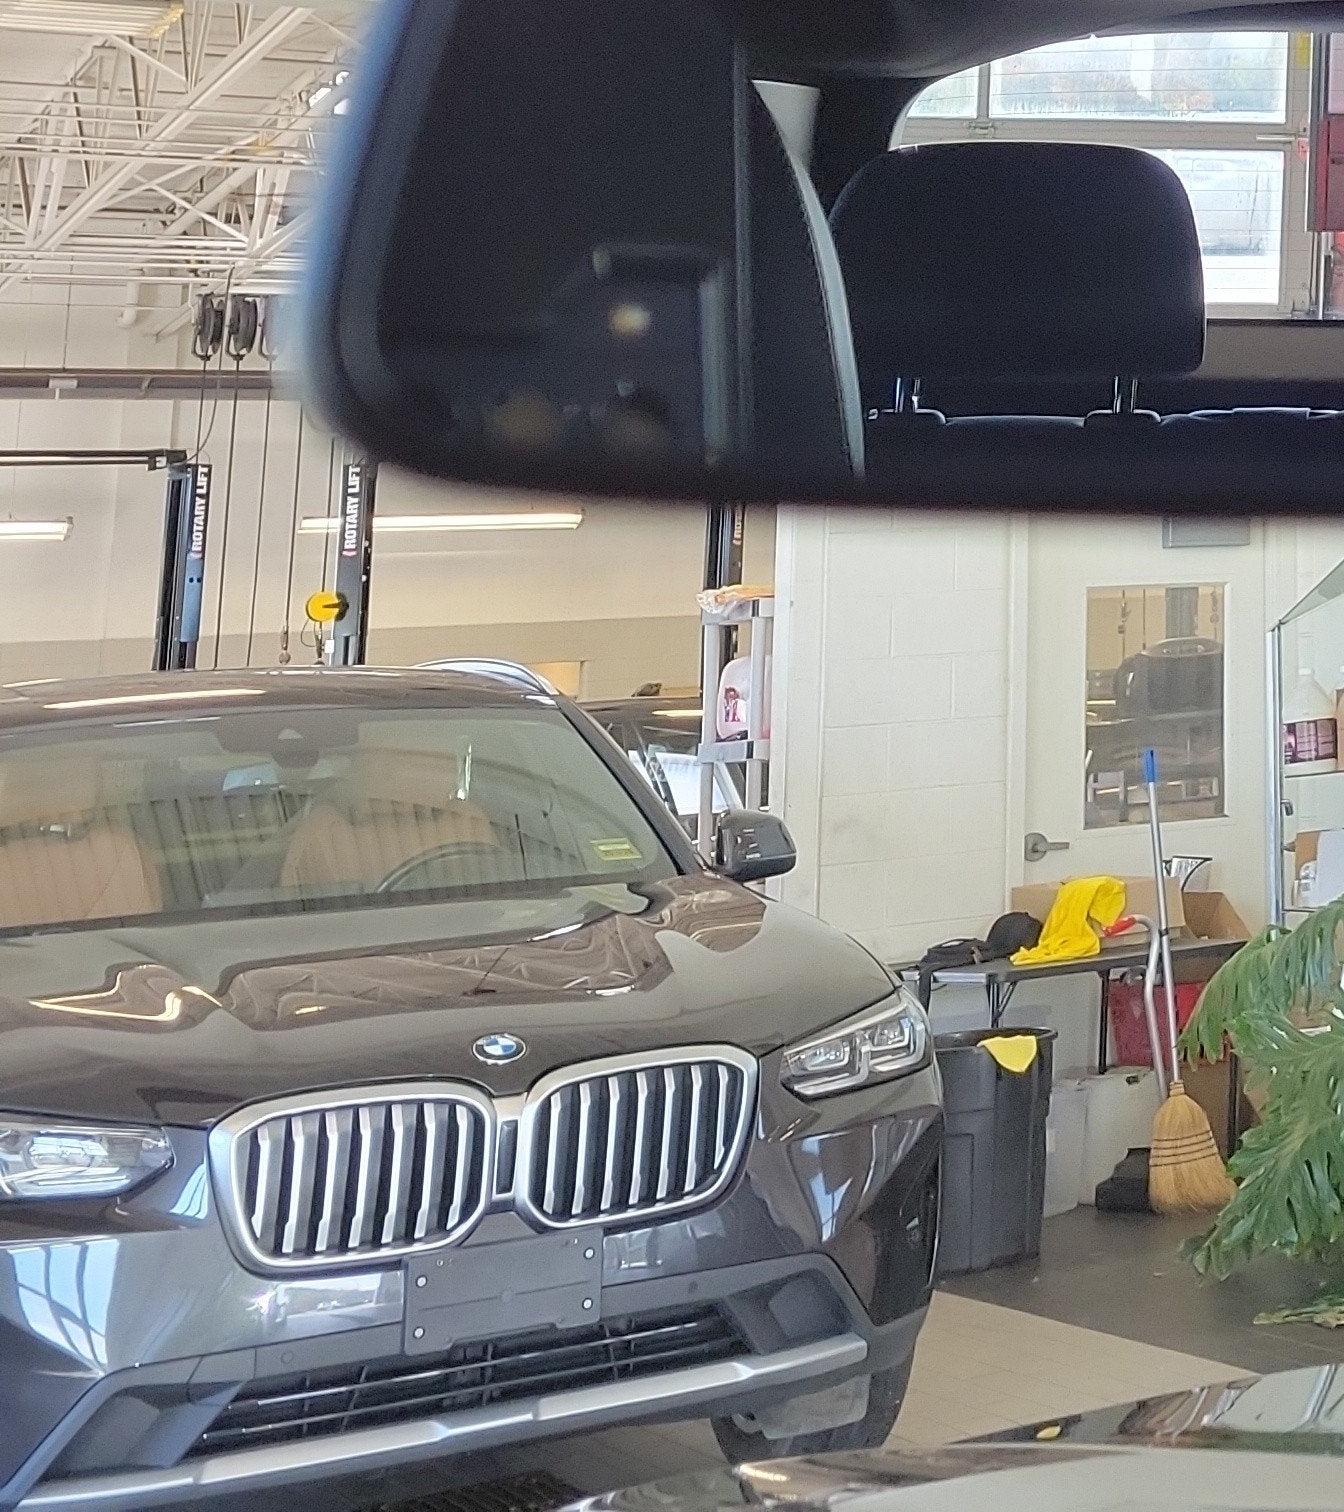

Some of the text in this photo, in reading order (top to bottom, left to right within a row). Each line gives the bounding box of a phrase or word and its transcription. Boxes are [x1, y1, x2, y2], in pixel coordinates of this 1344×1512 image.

[191, 466, 210, 551] ROTARY LIFT
[344, 465, 362, 549] ROTARY LIFT
